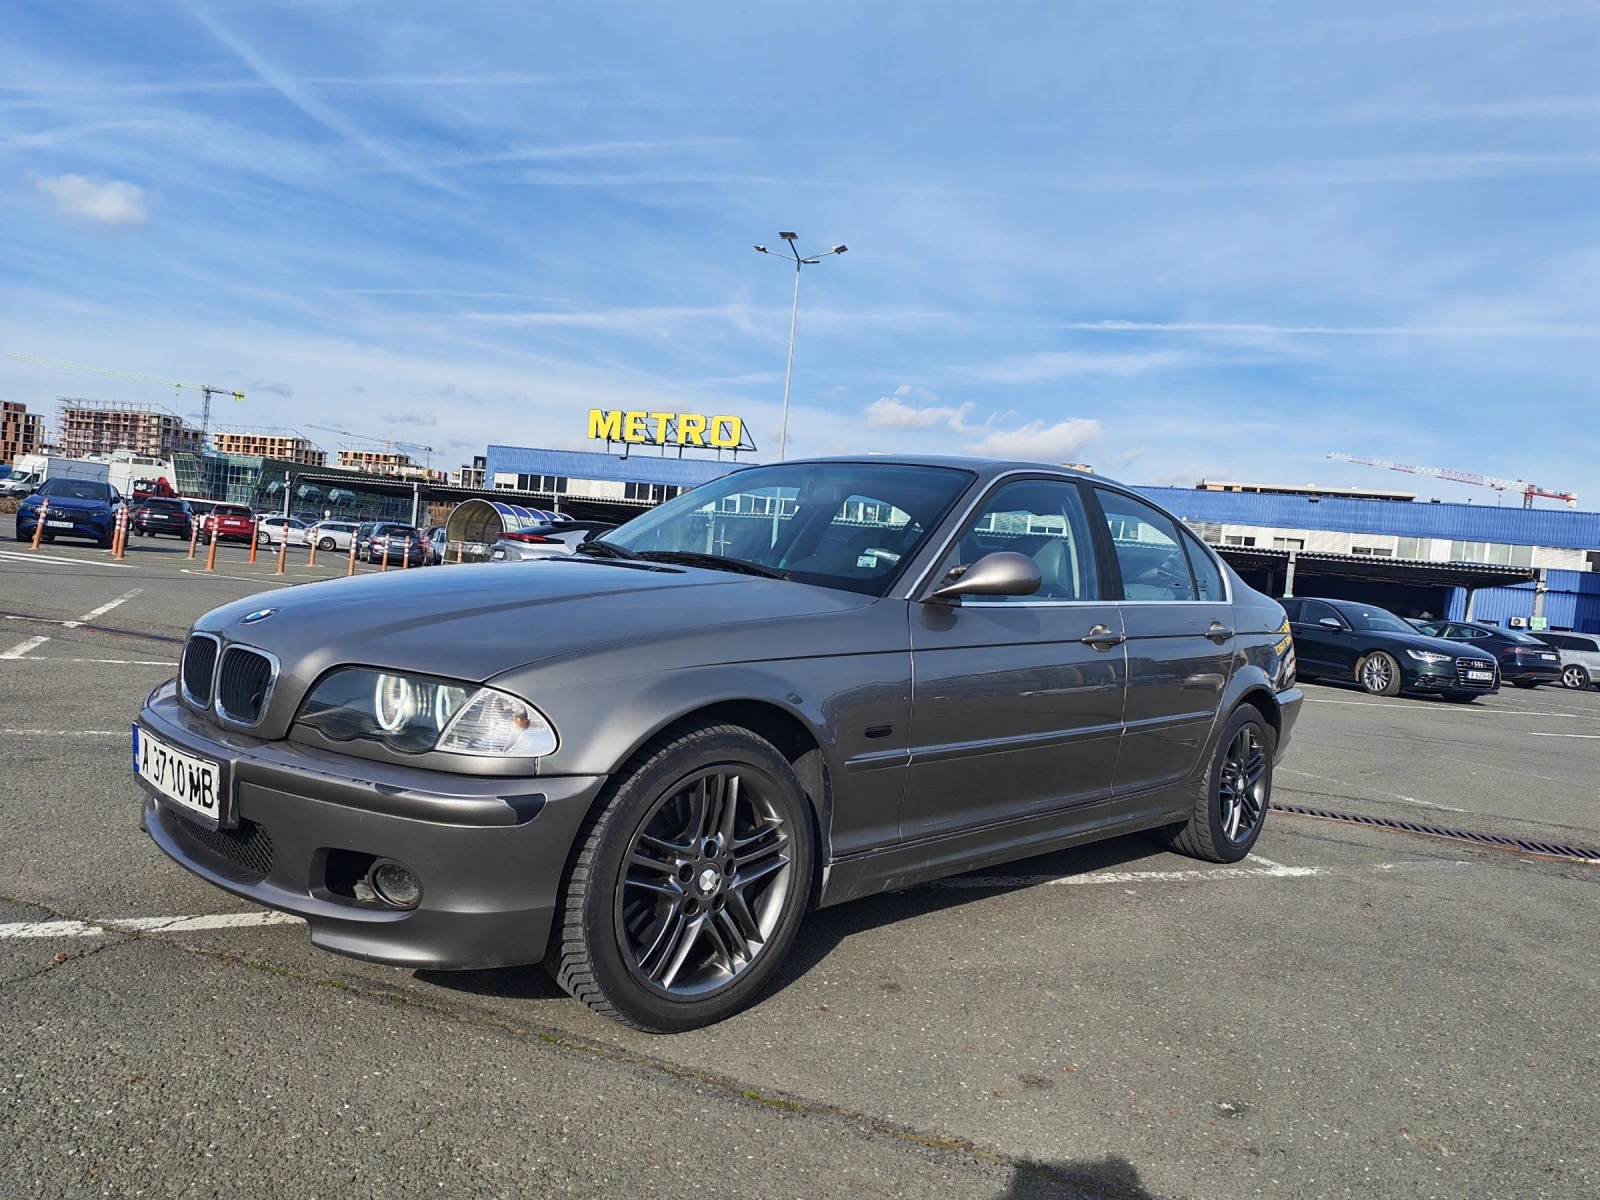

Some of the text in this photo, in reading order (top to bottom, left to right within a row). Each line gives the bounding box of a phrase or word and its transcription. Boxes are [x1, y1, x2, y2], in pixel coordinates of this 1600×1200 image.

[587, 408, 743, 447] METRO
[142, 738, 214, 809] A 3710 MB
